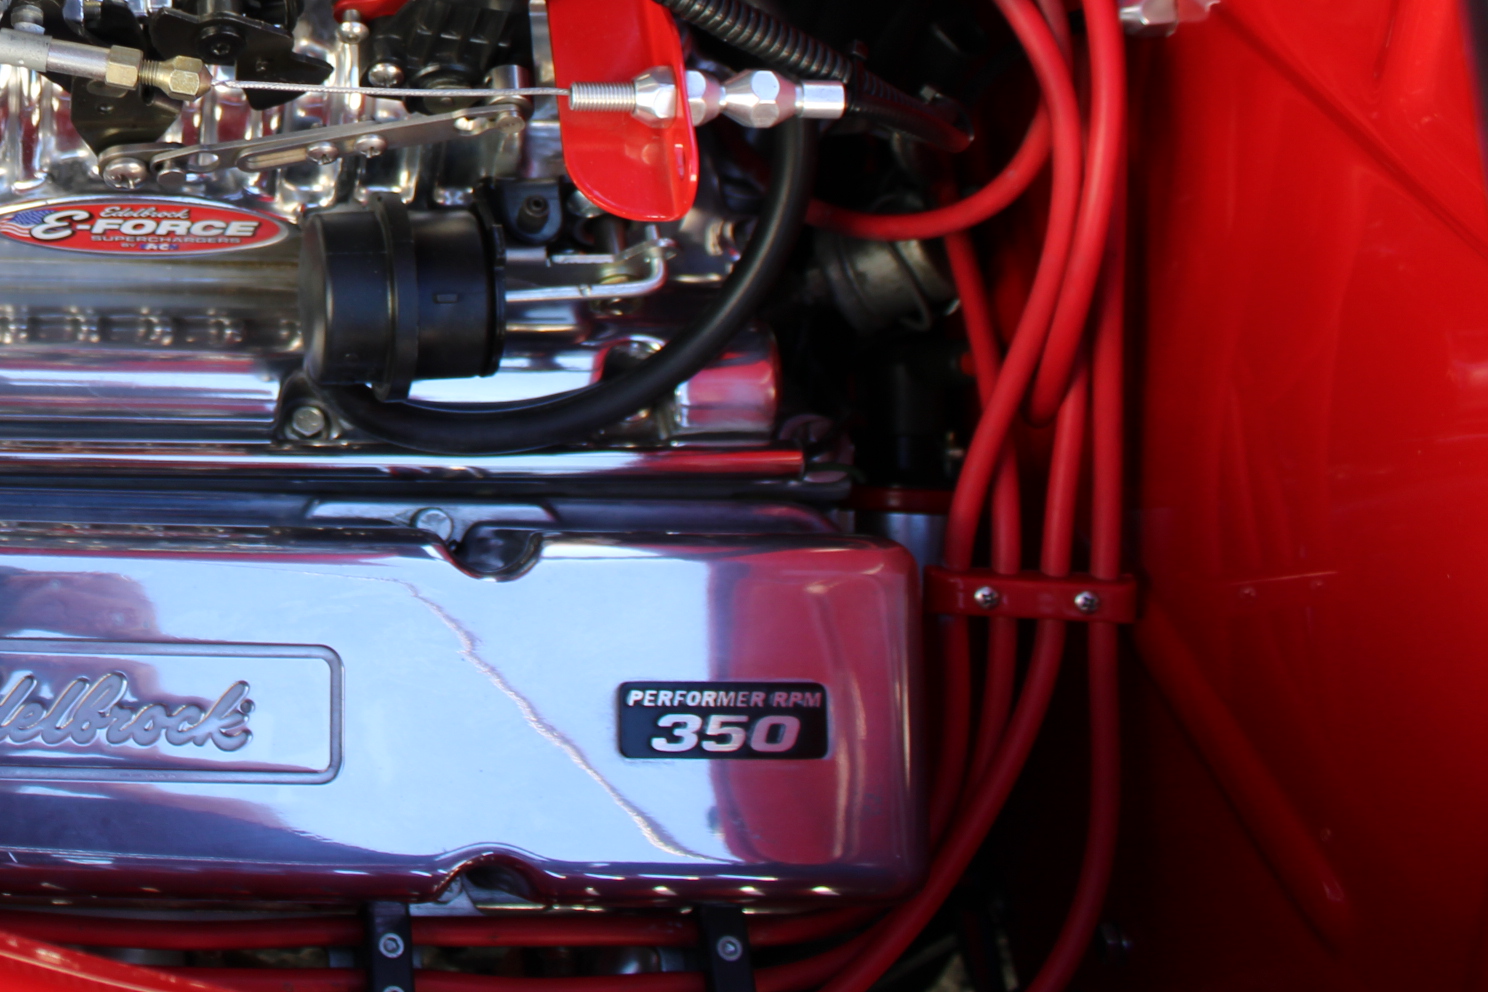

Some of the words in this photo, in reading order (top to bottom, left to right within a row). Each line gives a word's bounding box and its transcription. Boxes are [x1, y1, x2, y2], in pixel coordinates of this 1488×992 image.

[99, 206, 189, 219] Edelbrock
[29, 209, 262, 240] E-FORCE
[90, 234, 241, 243] SUPERCHARGERS
[626, 690, 766, 707] PERFORMER
[772, 691, 823, 708] RPM
[650, 713, 801, 753] 350
